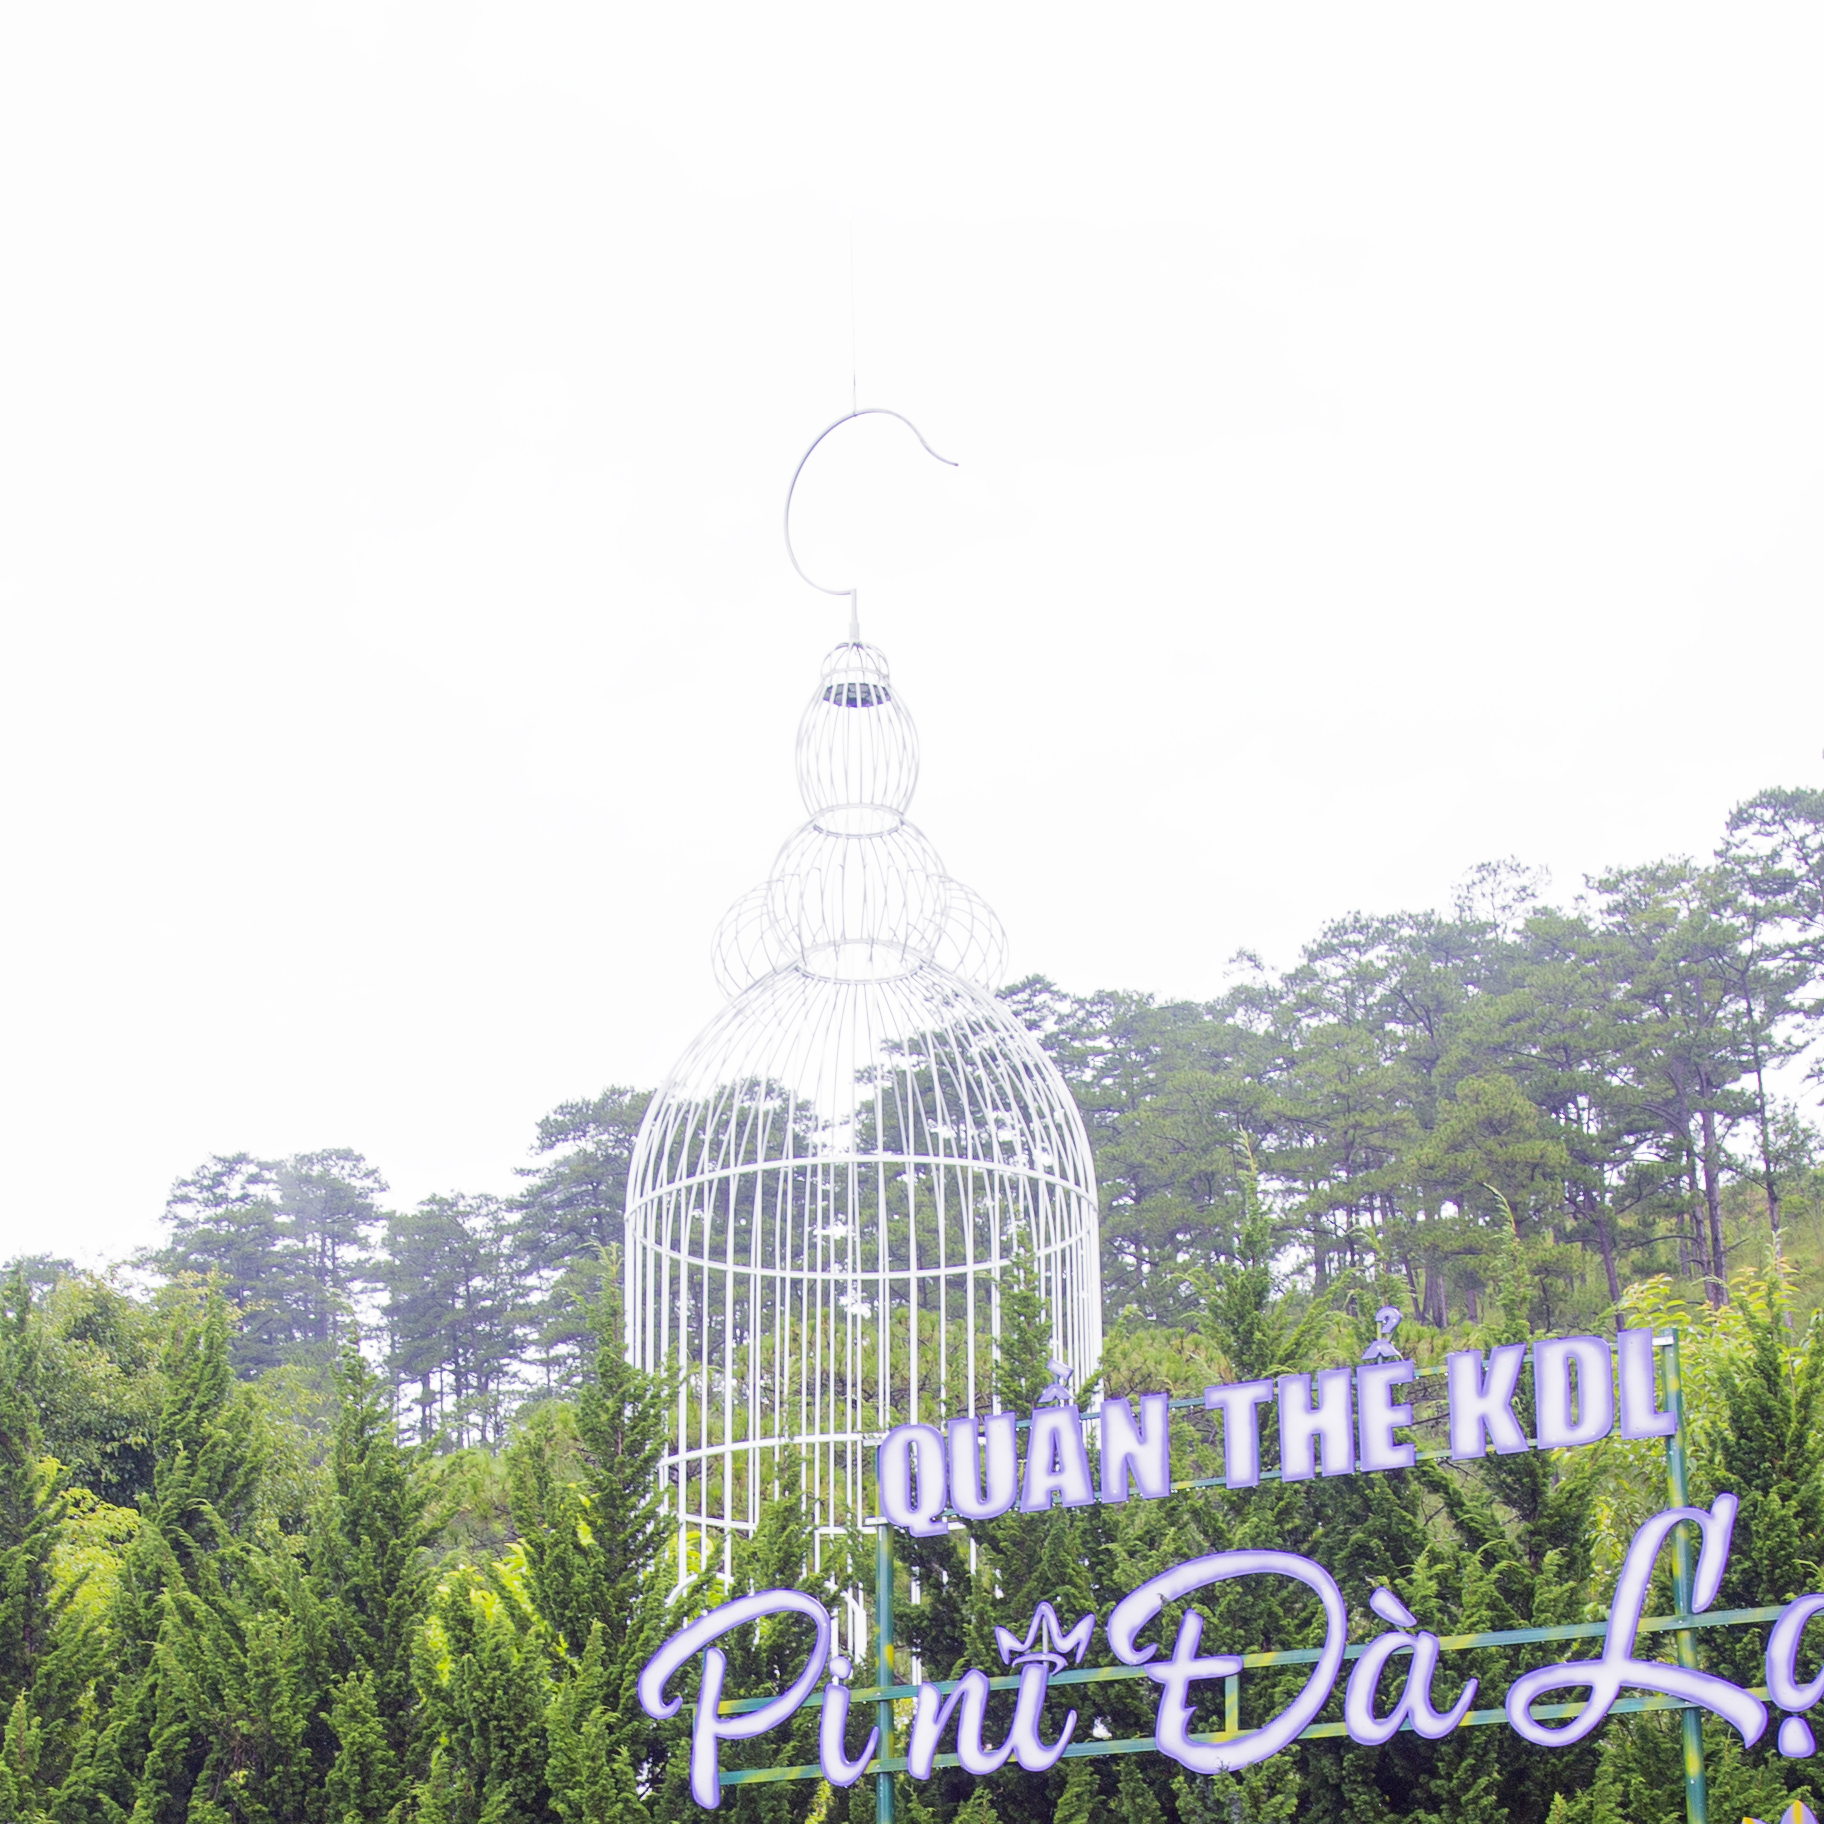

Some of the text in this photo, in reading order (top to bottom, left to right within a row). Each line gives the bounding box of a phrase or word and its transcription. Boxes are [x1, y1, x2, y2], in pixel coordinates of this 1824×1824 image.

[878, 1307, 1677, 1538] QUẦN THỂ KDL
[1107, 1549, 1479, 1775] Đà
